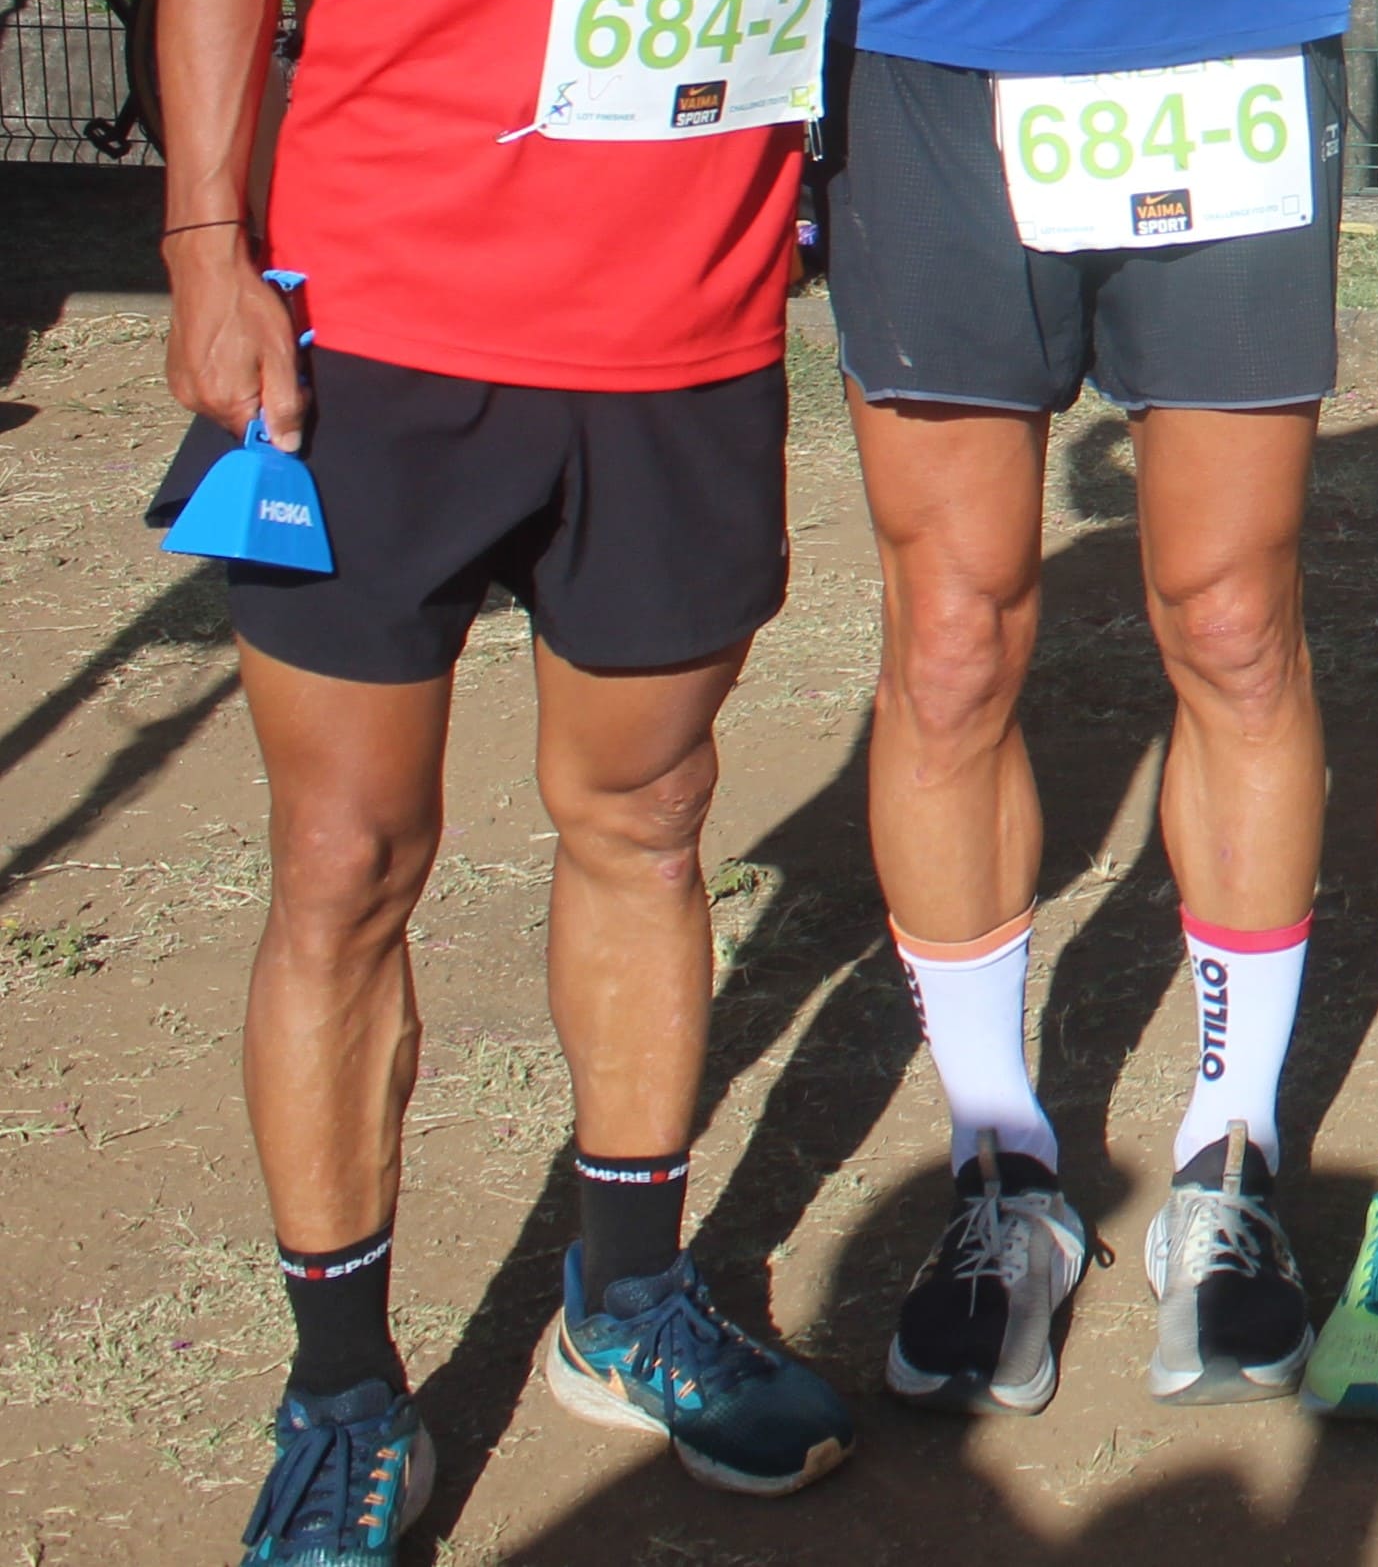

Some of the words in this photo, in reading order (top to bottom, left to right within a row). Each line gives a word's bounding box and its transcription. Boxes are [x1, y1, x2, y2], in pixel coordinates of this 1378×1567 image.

[678, 94, 719, 110] VAIMA
[675, 108, 718, 126] SPORT
[1018, 83, 1288, 185] 684-6
[1136, 202, 1186, 218] VAIMA
[1137, 216, 1188, 235] SPORT
[260, 499, 314, 527] HOKA
